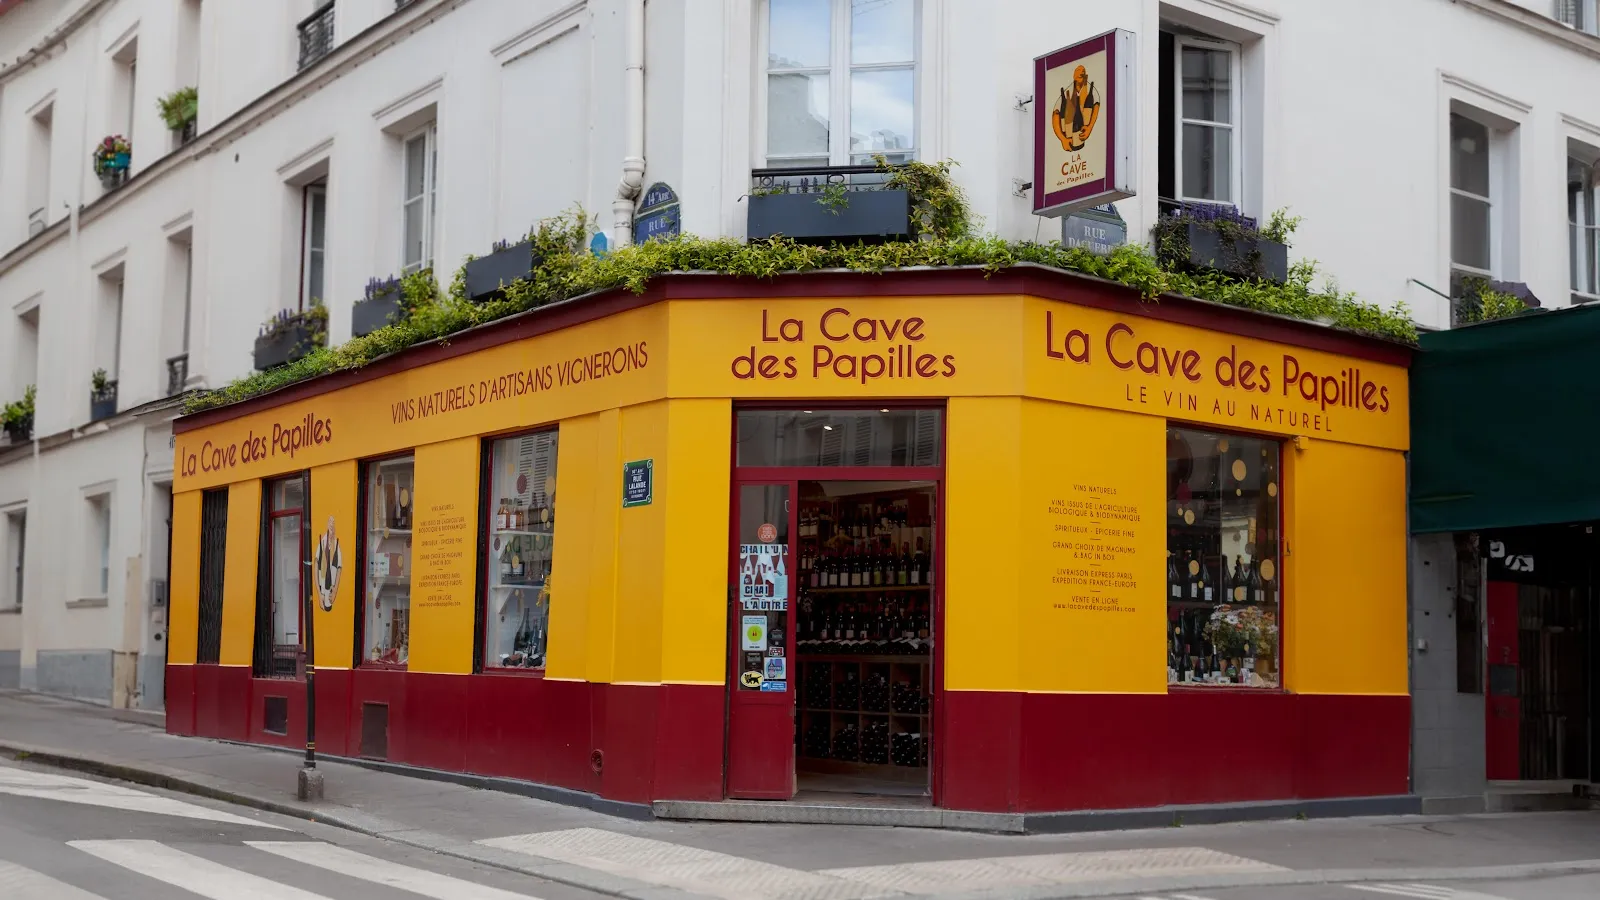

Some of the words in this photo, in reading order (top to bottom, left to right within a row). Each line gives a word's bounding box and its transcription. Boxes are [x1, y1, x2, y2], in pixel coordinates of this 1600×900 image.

[1071, 154, 1081, 162] LA
[1061, 161, 1087, 176] CAVE
[1067, 172, 1094, 183] Papilles
[649, 218, 666, 232] RUE
[1084, 226, 1106, 240] RUE
[762, 309, 804, 342] La
[819, 307, 925, 342] Cave
[731, 346, 798, 380] des
[813, 345, 956, 385] Papilles
[1047, 310, 1091, 363] La
[1105, 322, 1202, 382] Cave
[1215, 345, 1271, 393] des
[1283, 354, 1390, 414] Papilles
[391, 398, 415, 424] VINS
[418, 383, 476, 418] NATURELS
[479, 365, 553, 405] D'ARTISANS
[557, 341, 648, 387] VIGNERONS
[1126, 384, 1147, 403] LE
[1164, 390, 1198, 411] VIN
[1213, 399, 1235, 417] AU
[1251, 404, 1332, 432] NATUREL
[181, 446, 197, 477] La
[201, 440, 237, 472] Cave
[241, 430, 267, 464] des
[272, 412, 332, 458] Papilles
[1089, 486, 1117, 495] NATURELS
[1048, 507, 1087, 516] BIOLOGIQUE
[1096, 512, 1140, 522] BIODYNAMIQUE
[1055, 525, 1088, 533] SPIRITUEUX
[1053, 542, 1072, 550] GRAND
[1106, 546, 1136, 554] MAGNUMS
[1081, 552, 1092, 560] BAG
[1057, 568, 1088, 577] LIVRAISON
[1091, 570, 1115, 579] EXPRESS
[1118, 572, 1132, 580] PARIS
[1090, 579, 1136, 588] FRANCE-EUROPE
